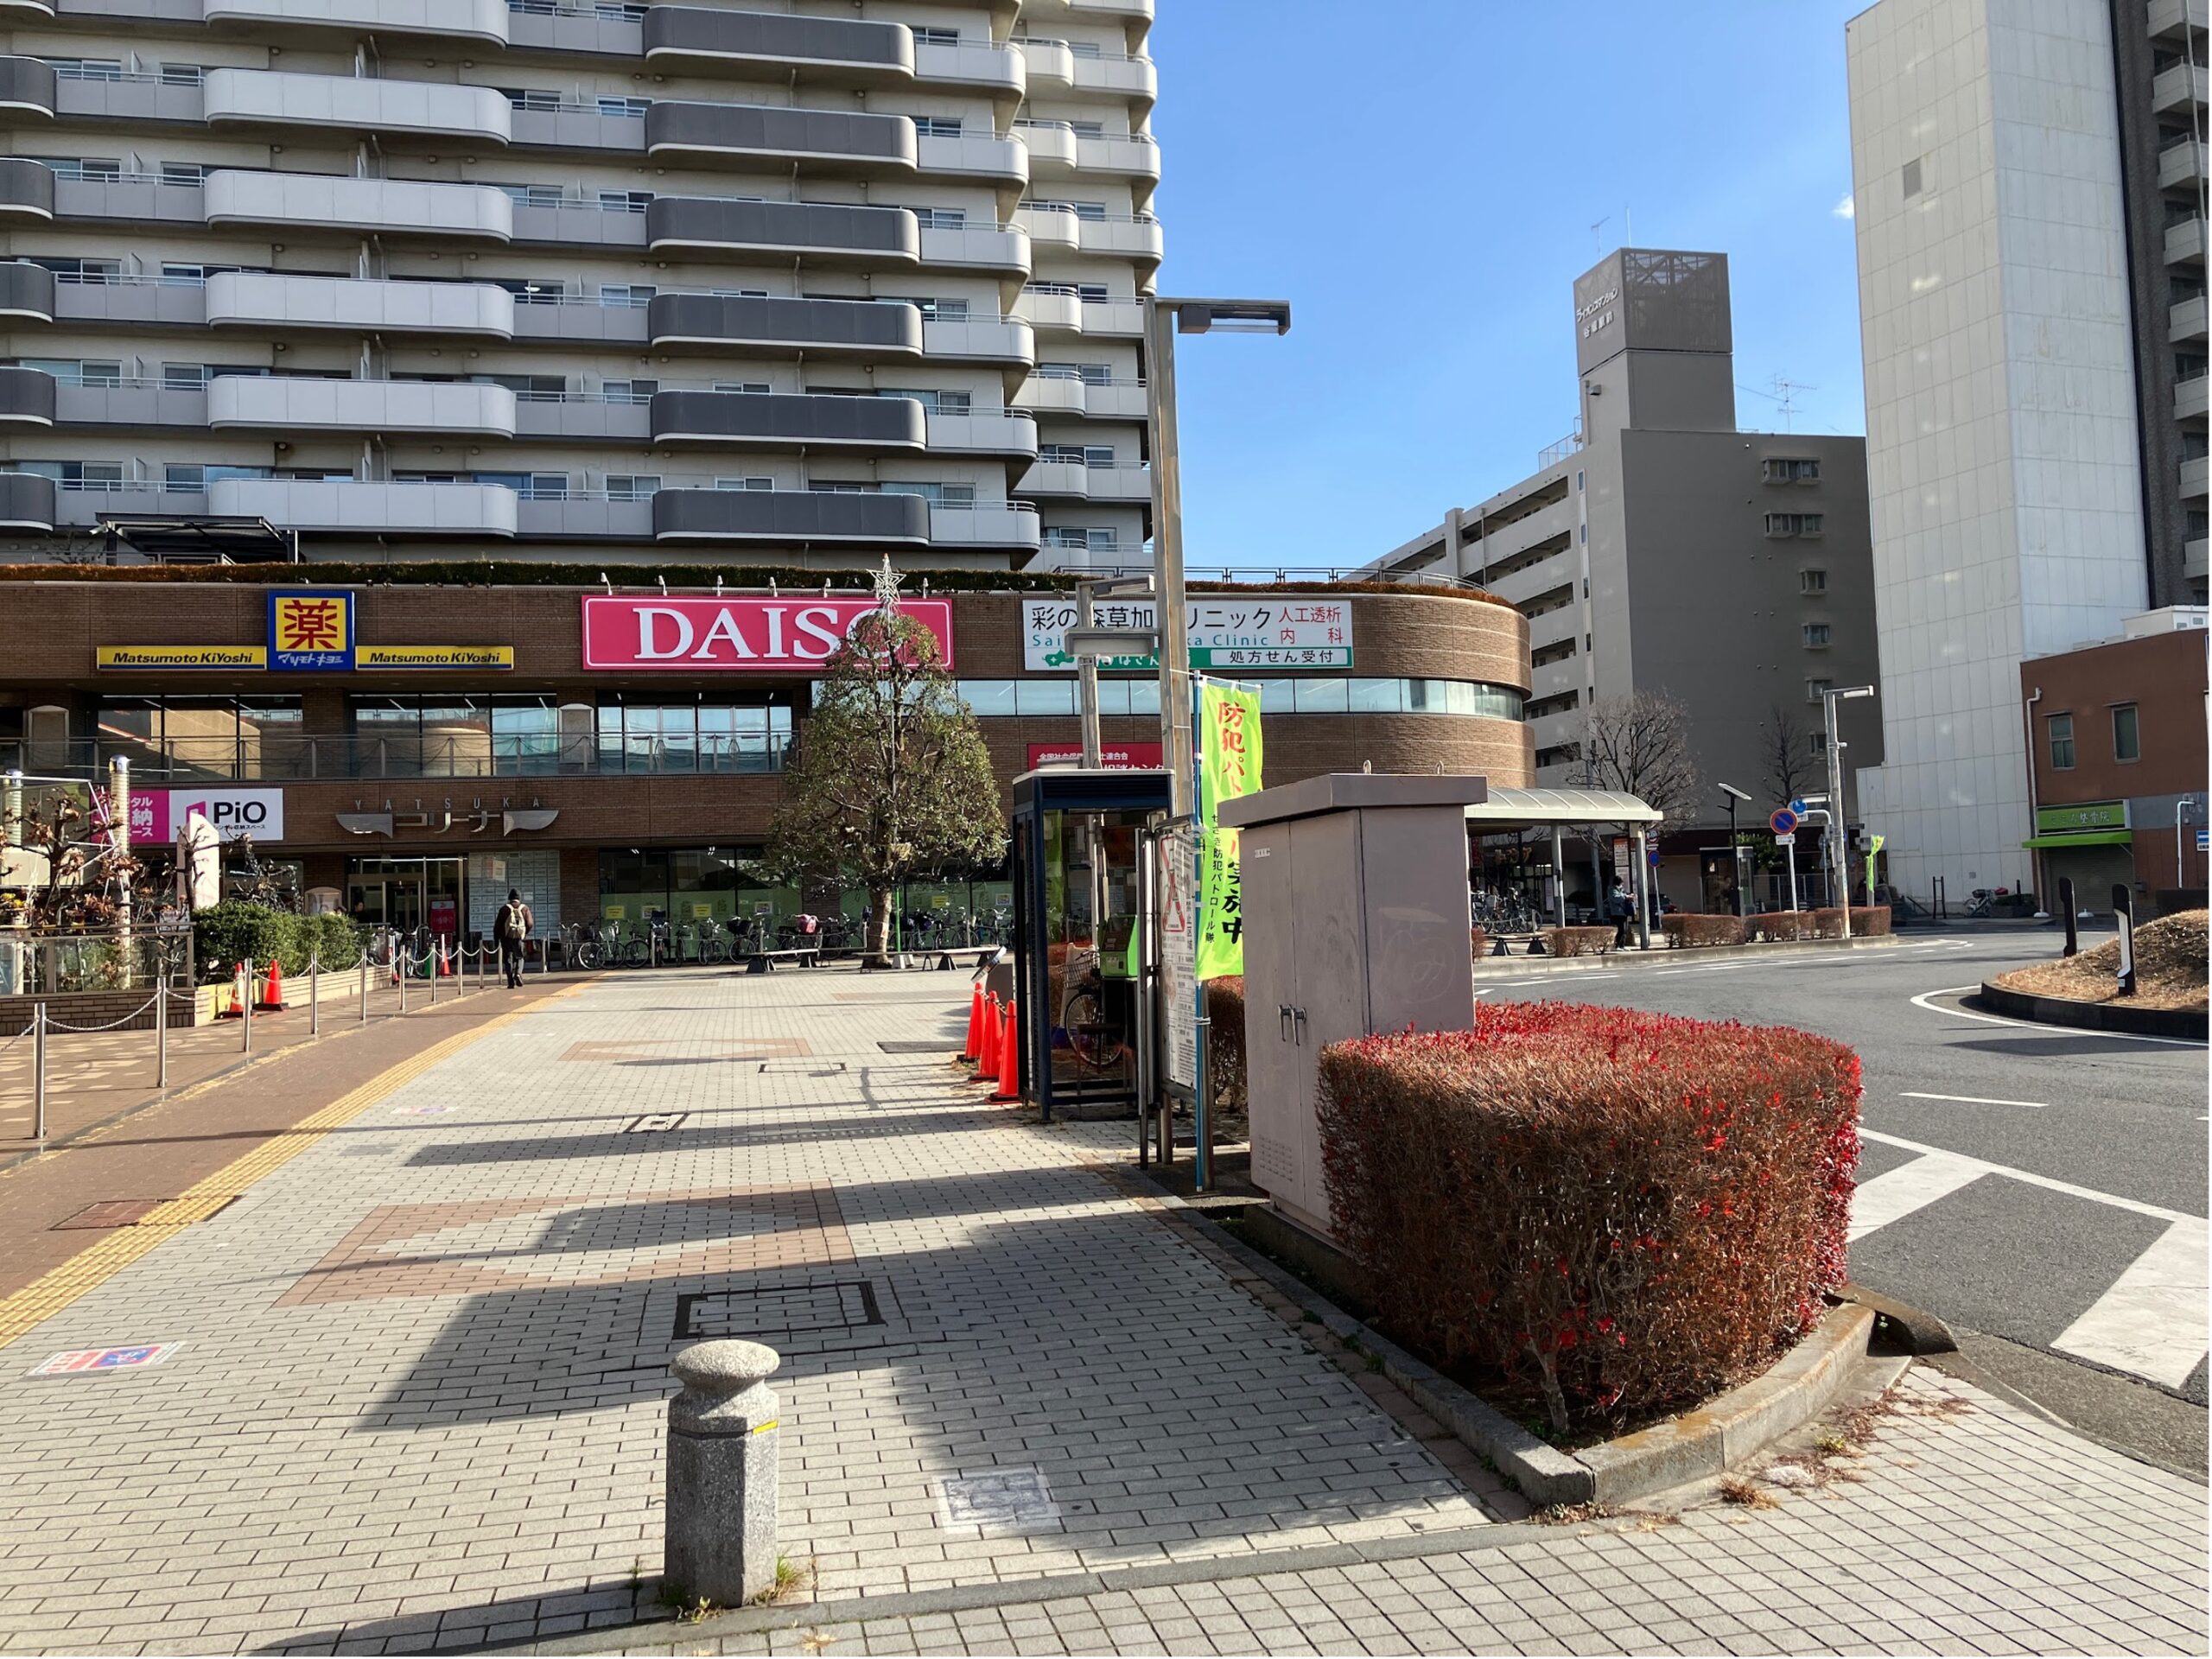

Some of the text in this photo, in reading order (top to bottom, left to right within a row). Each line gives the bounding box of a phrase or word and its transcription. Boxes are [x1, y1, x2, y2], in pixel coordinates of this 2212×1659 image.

[1279, 606, 1342, 624] 人工透析
[284, 600, 337, 649] 薬
[1212, 634, 1268, 646] Clinic
[113, 652, 253, 664] Matsumoto KiYoshi
[370, 652, 500, 664] Matsumoto KiYoshi
[1230, 650, 1333, 664] 処方せん受付
[355, 797, 539, 810] YATSUKA
[213, 802, 266, 823] PiO
